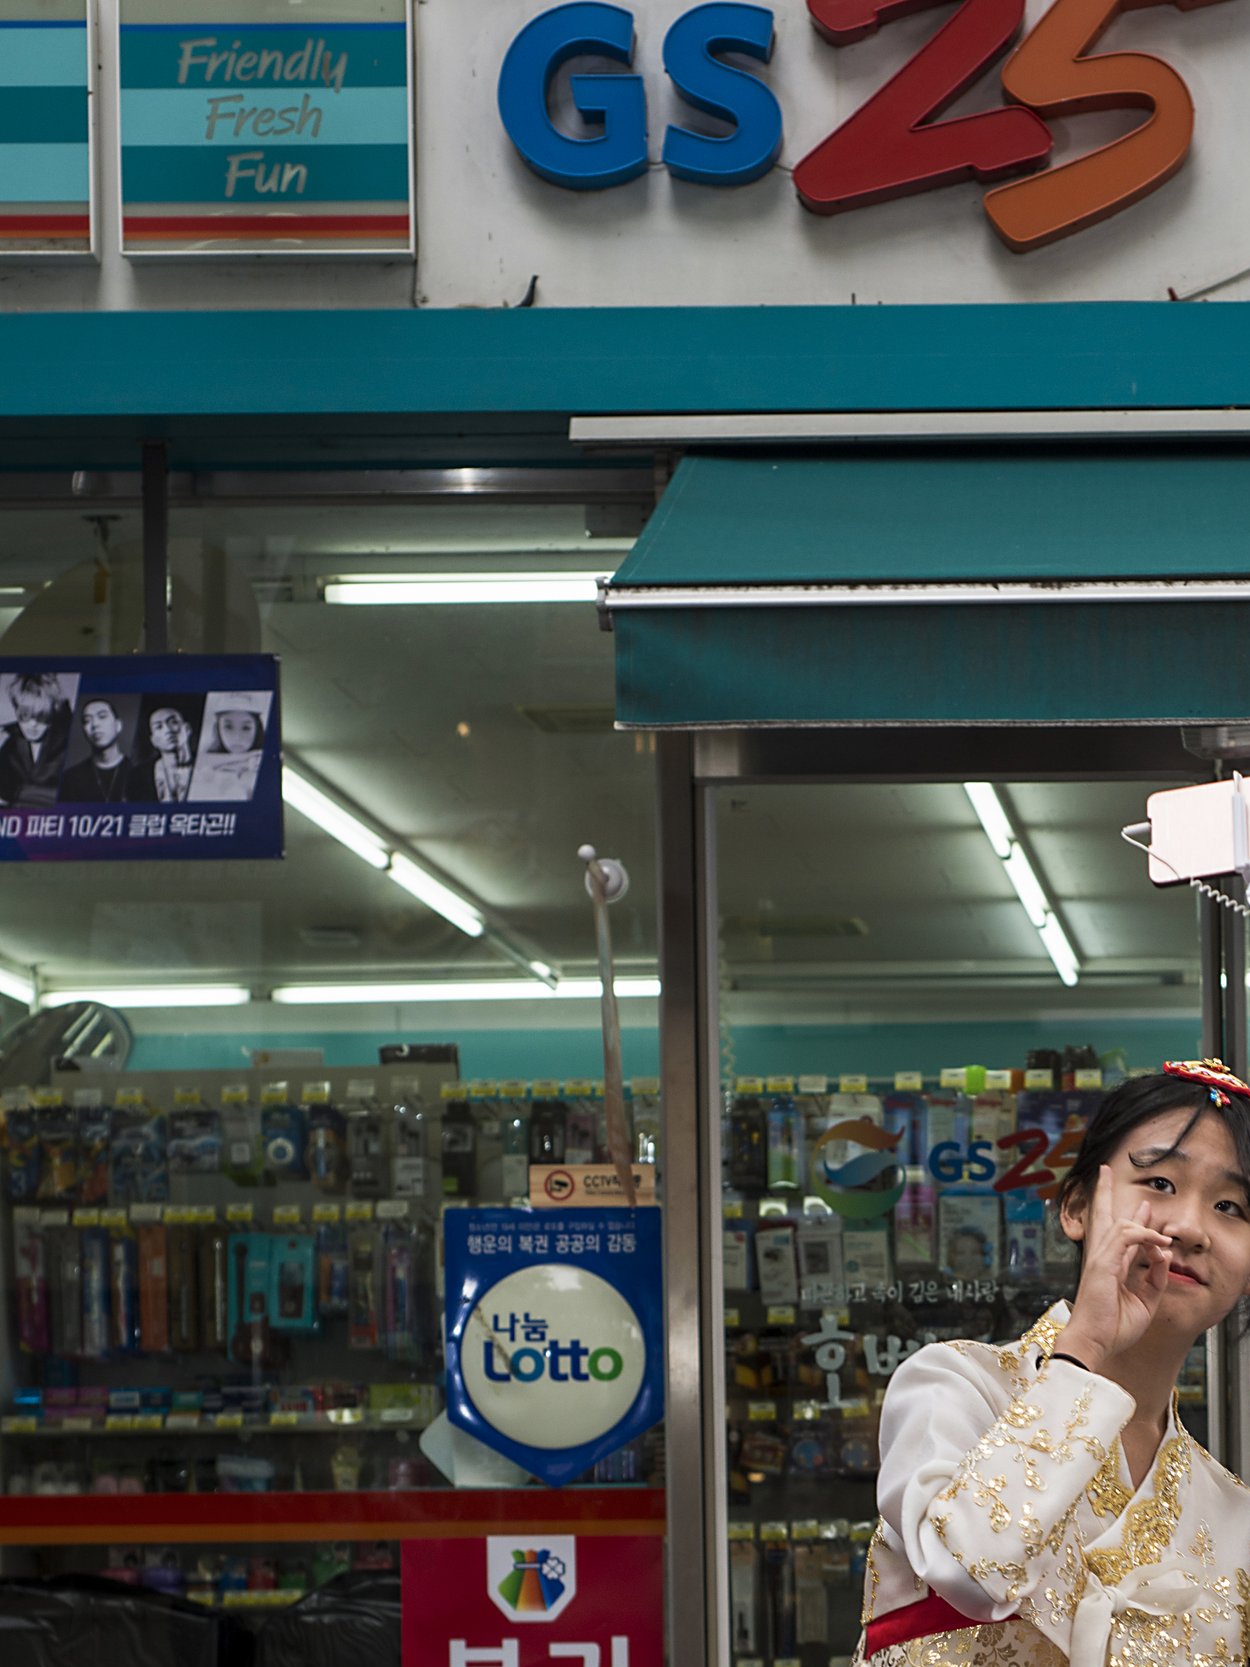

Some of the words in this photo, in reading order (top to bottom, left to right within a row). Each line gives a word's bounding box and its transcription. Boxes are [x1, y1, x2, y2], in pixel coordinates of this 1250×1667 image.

[177, 37, 348, 94] Friendly
[205, 93, 323, 140] Fresh
[498, 0, 1237, 254] GS25
[225, 151, 307, 198] Fun
[26, 814, 65, 838] 파티
[69, 814, 123, 837] 10/21
[129, 813, 165, 837] 클럽
[170, 813, 236, 837] 옥타곤!!
[467, 1234, 512, 1254] 행운의
[518, 1235, 549, 1254] 복권
[555, 1234, 600, 1254] 공공의
[607, 1233, 637, 1254] 감동
[492, 1312, 549, 1342] 나눔
[483, 1340, 624, 1382] Lotto
